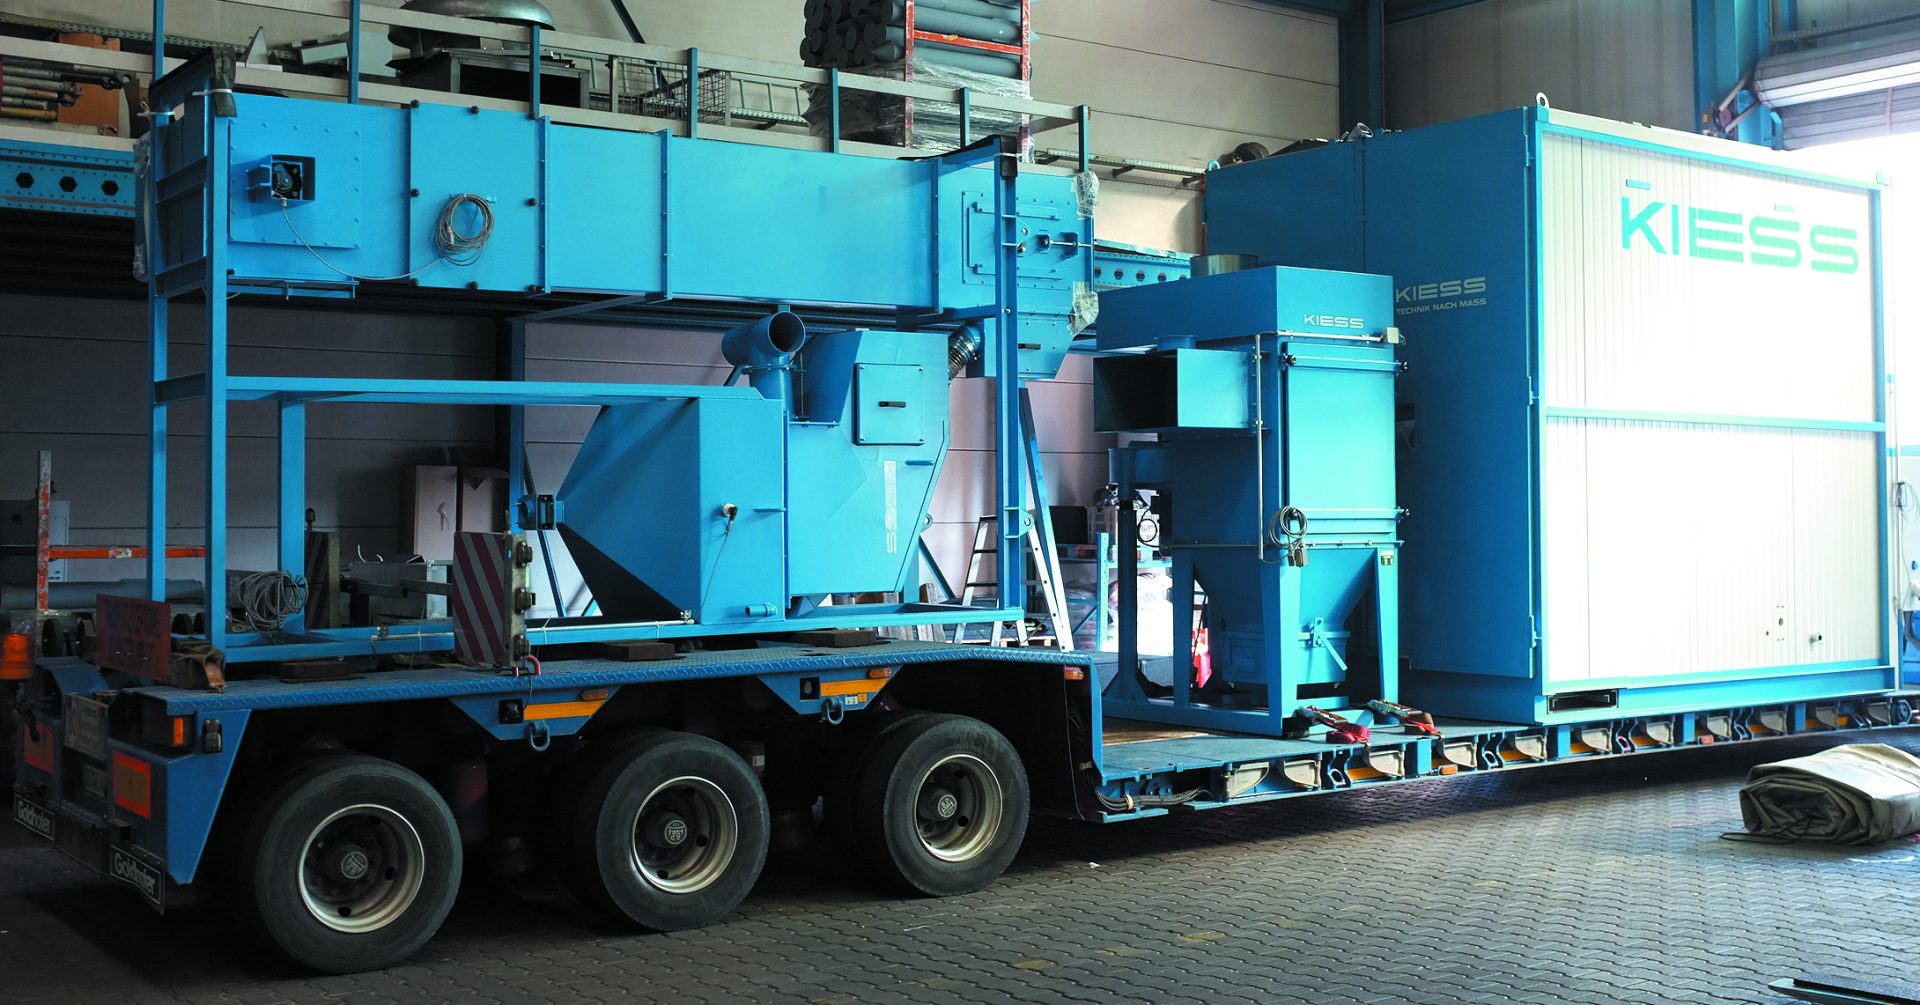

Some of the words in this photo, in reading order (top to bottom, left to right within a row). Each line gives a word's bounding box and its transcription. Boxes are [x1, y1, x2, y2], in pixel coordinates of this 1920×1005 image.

[1621, 195, 1860, 274] KIESS
[1395, 276, 1486, 303] KIESS
[1396, 304, 1431, 315] TECHNIK
[1433, 301, 1458, 311] NACH
[1459, 297, 1487, 308] MASS
[1303, 314, 1364, 328] KIESS
[114, 852, 155, 895] Goldhofer
